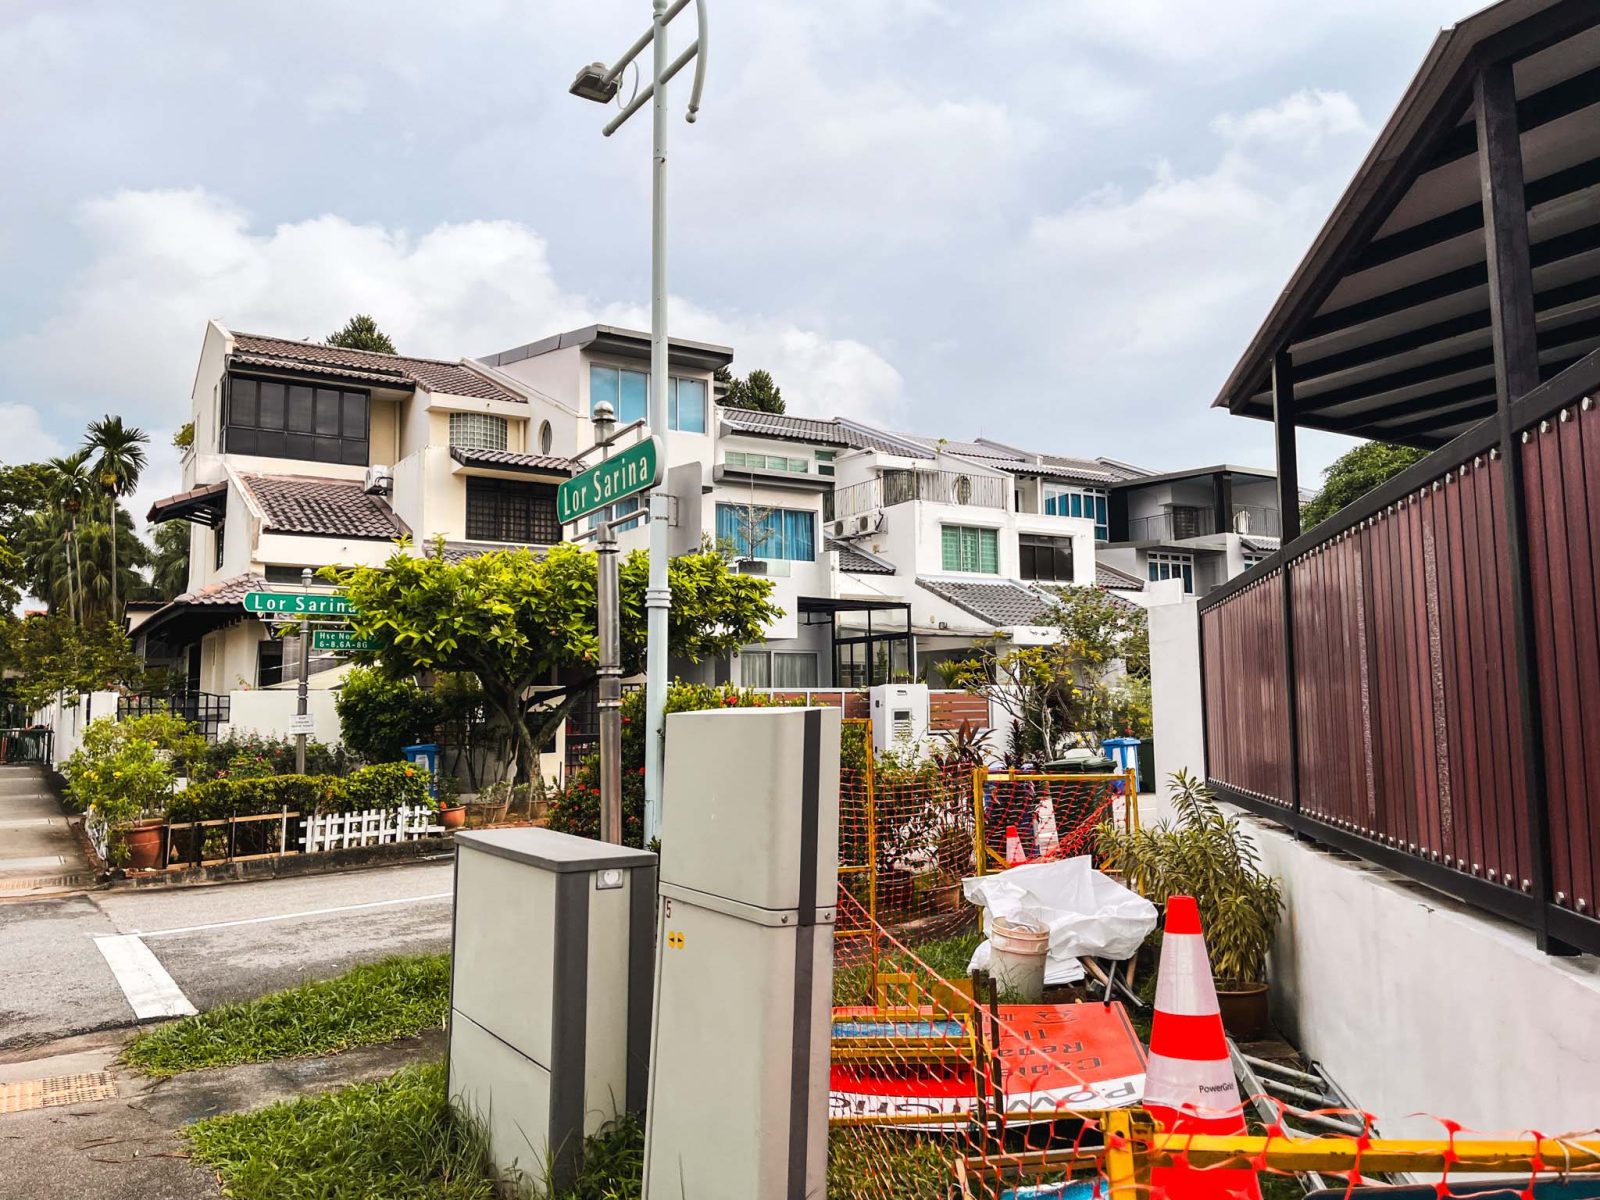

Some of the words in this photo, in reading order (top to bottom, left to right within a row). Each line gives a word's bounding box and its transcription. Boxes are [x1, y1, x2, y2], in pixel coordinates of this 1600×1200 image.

[563, 486, 587, 515] Lor
[593, 457, 648, 502] Sarina
[254, 595, 286, 610] Lor
[295, 597, 356, 614] Sarina
[319, 632, 336, 640] Hse
[666, 900, 672, 919] 5
[1000, 1041, 1083, 1058] Repa
[1198, 1082, 1234, 1094] PowerGrid
